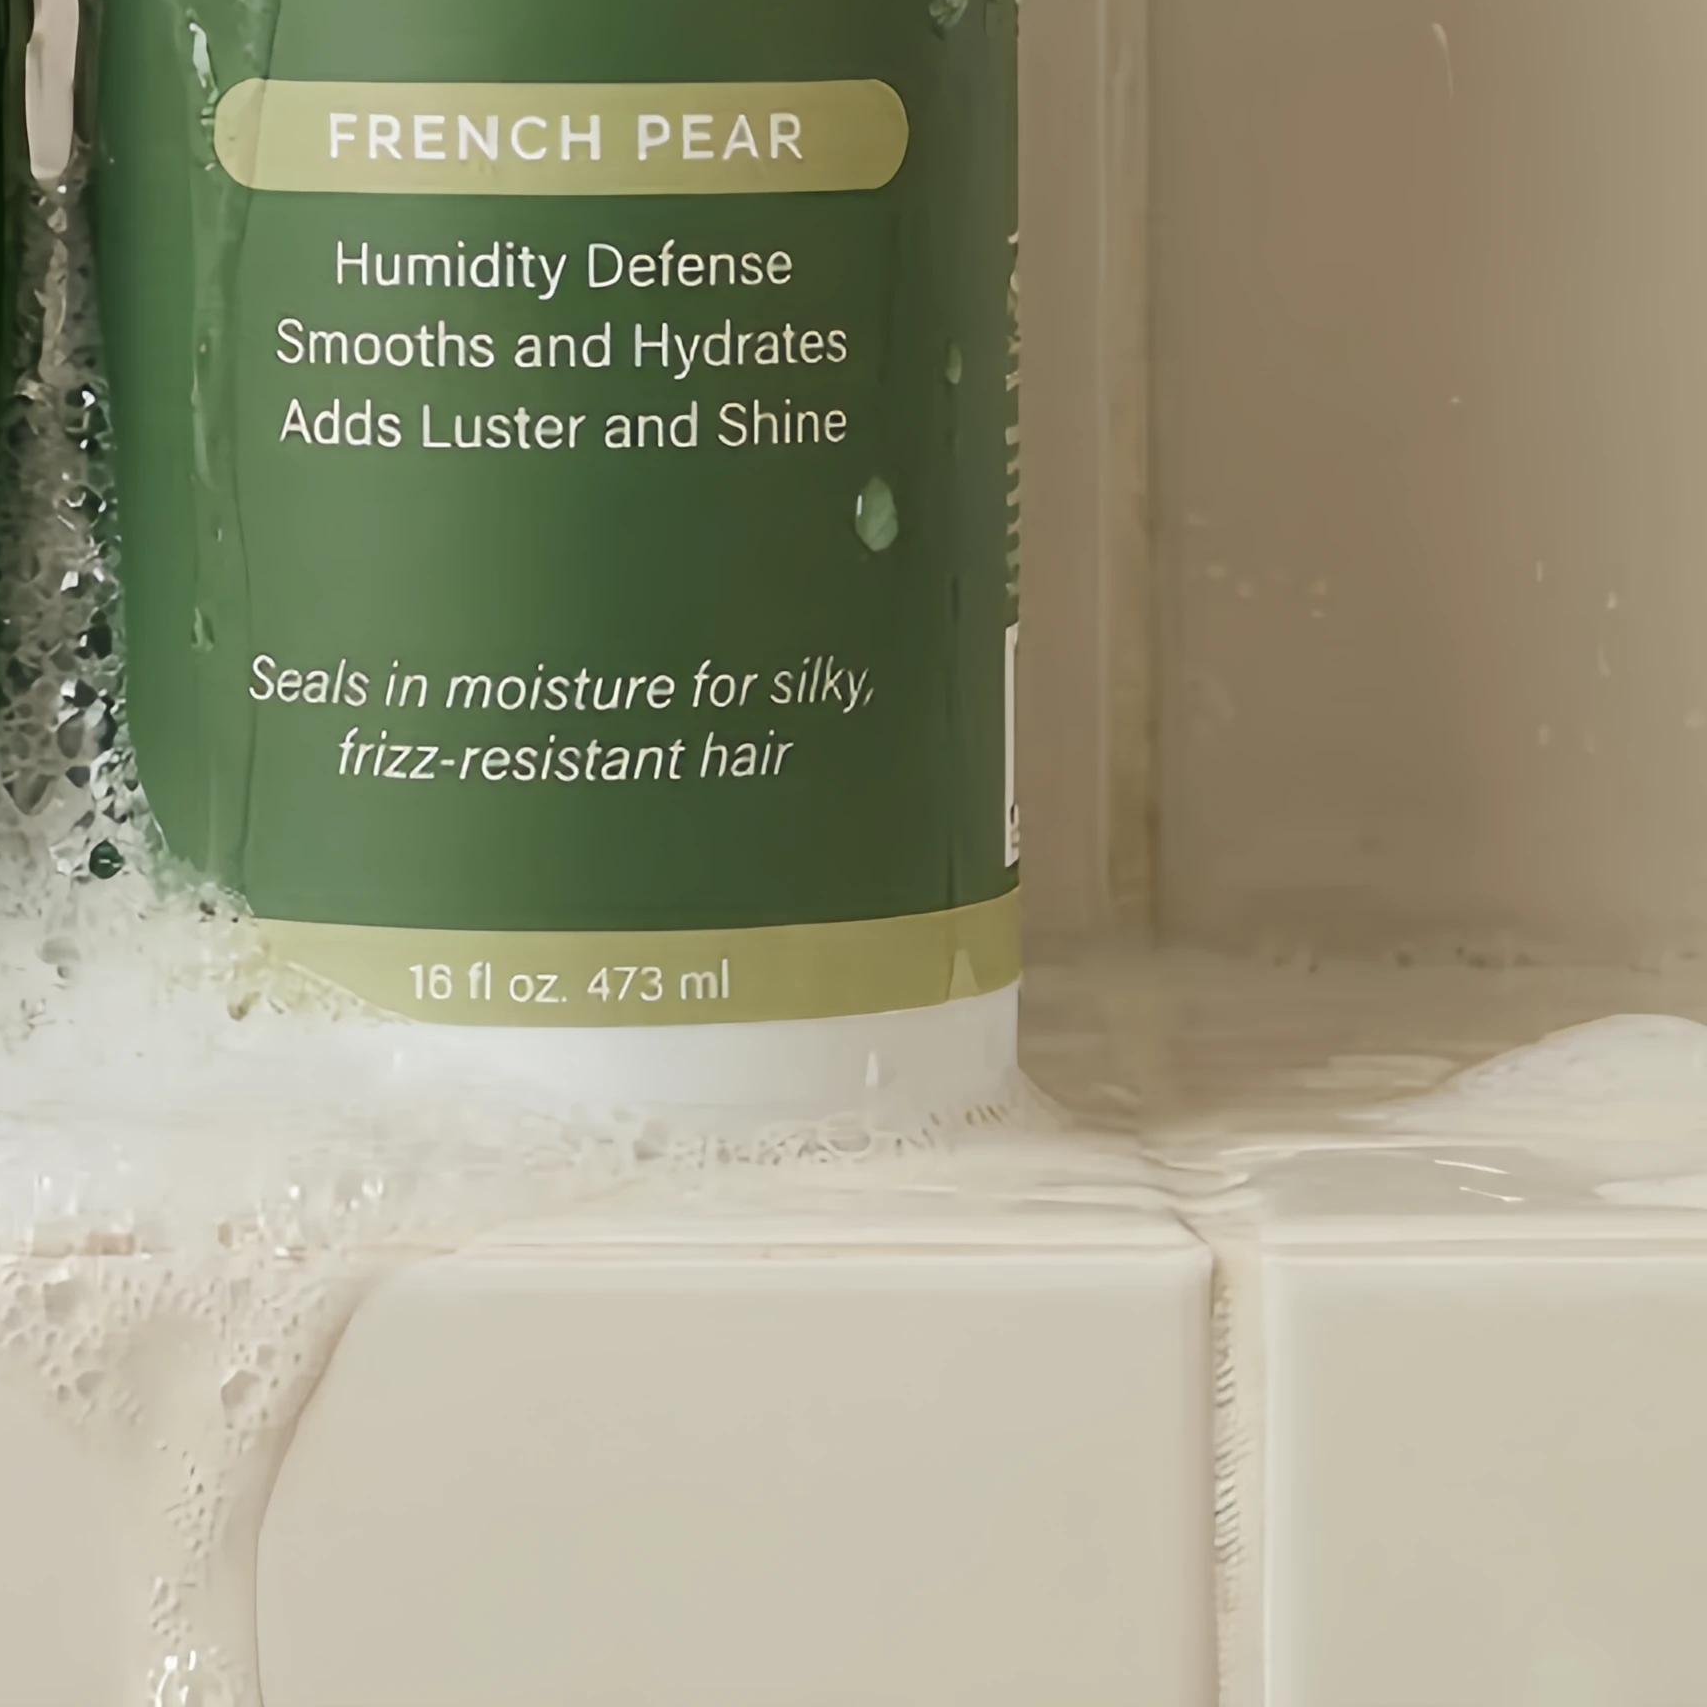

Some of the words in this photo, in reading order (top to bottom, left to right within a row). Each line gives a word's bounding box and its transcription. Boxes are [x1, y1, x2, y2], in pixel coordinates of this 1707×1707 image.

[330, 113, 601, 161] FRENCH
[638, 113, 802, 161] PEAR
[337, 241, 566, 300] Humidity
[588, 239, 792, 288] Defense
[277, 318, 494, 367] Smooths
[515, 322, 610, 367] and
[635, 319, 846, 380] Hydrates
[280, 398, 401, 447] Adds
[423, 405, 586, 449] Luster
[605, 401, 697, 448] and
[718, 399, 846, 446] Shine
[249, 655, 369, 706] Seals
[386, 660, 427, 707] in
[446, 661, 675, 710] moisture
[693, 660, 758, 707] for
[770, 656, 873, 713] silky,
[339, 727, 686, 781] frizz-resistant
[700, 730, 793, 777] hair
[409, 964, 452, 999] 16
[468, 961, 491, 1000] fl
[509, 974, 567, 1002] oz.
[587, 966, 663, 1001] 473
[680, 959, 729, 1000] ml
